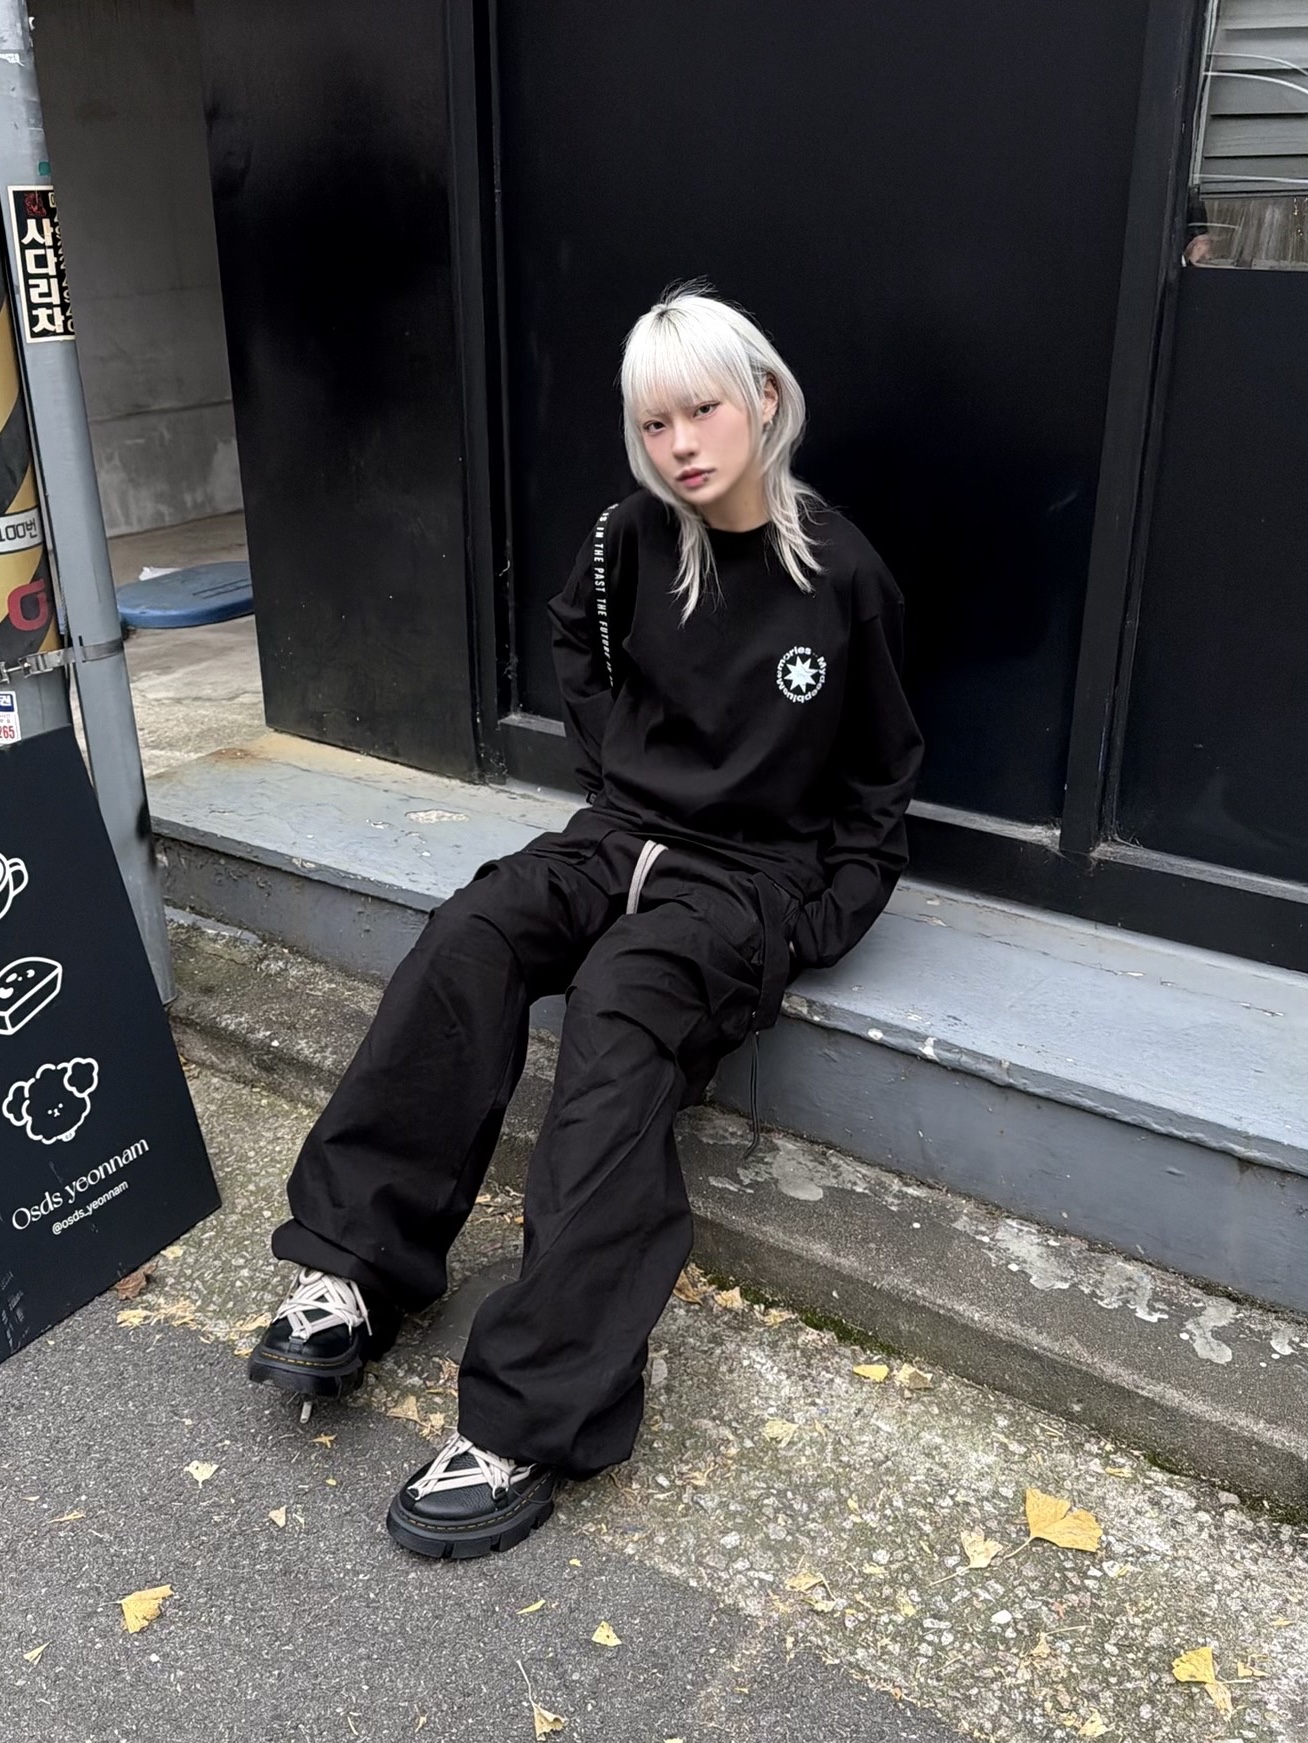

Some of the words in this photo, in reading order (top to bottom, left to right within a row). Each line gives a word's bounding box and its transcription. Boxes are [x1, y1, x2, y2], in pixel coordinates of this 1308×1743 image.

[21, 217, 65, 334] 사다리차
[595, 527, 604, 538] IN
[593, 543, 604, 563] THE
[594, 567, 606, 593] PAST
[596, 598, 607, 617] THE
[11, 1192, 63, 1230] Osds
[64, 1138, 150, 1204] yeonnam
[51, 1180, 129, 1236] @osds_yeonnam
